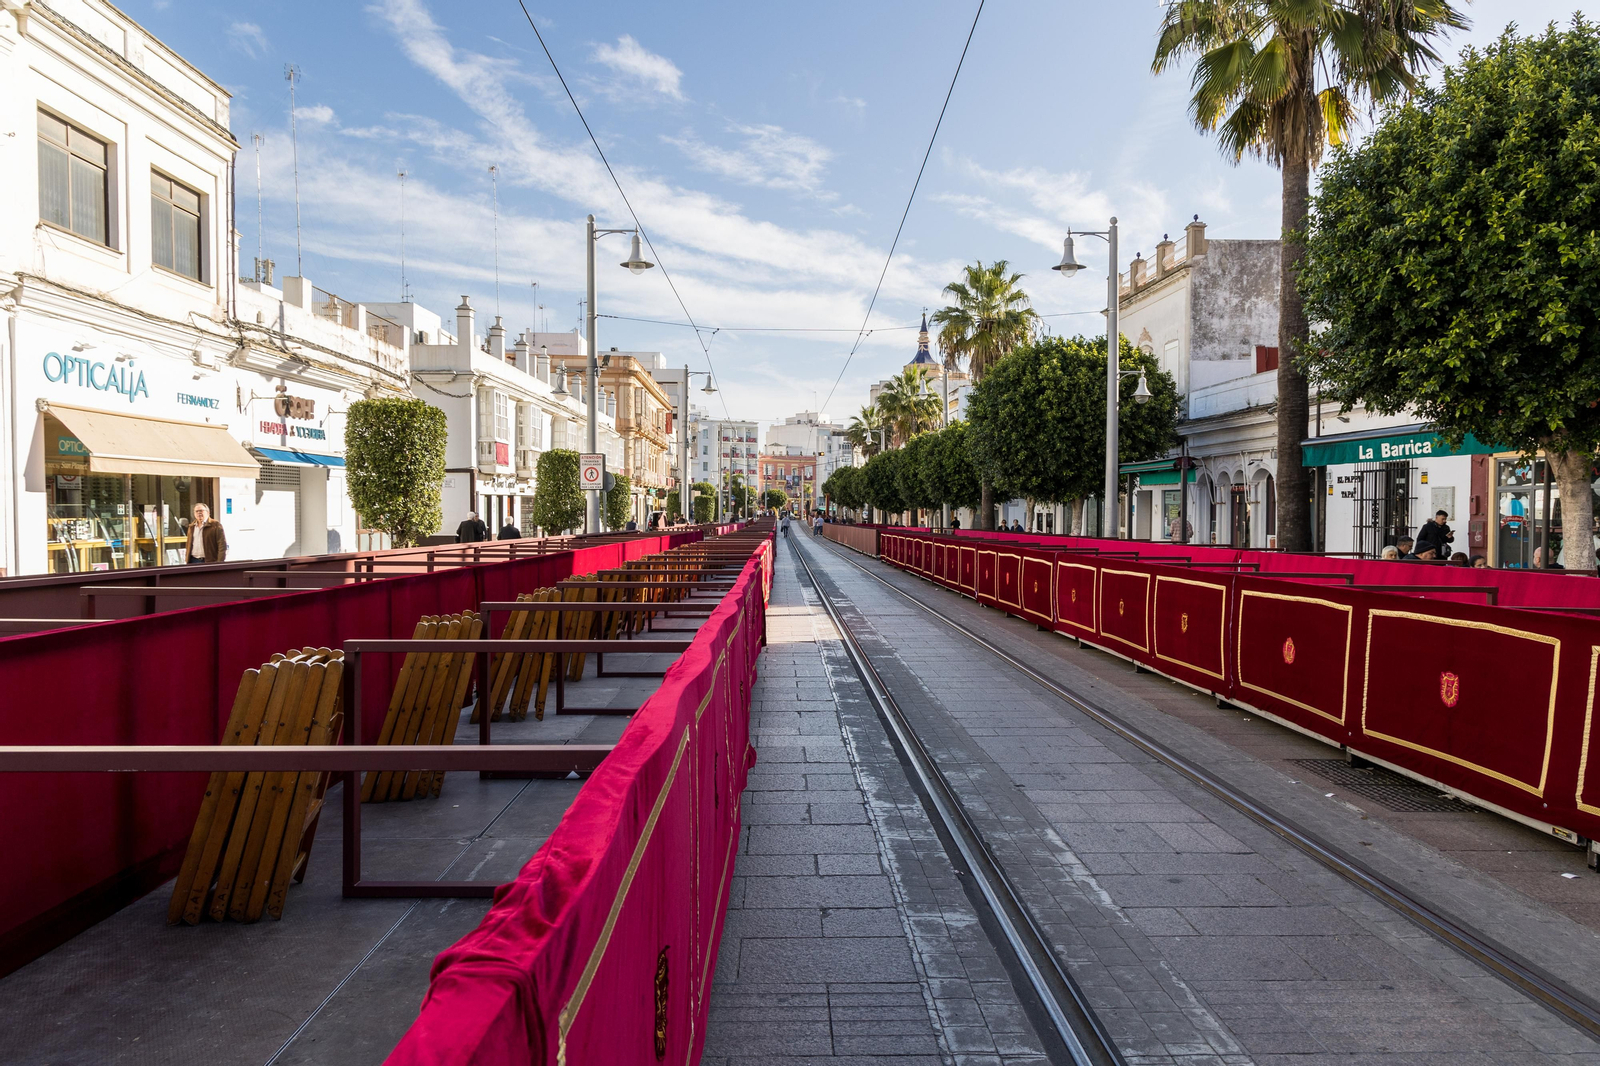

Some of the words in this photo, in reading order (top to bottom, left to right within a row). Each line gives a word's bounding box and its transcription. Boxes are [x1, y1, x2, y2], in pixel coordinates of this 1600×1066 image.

[177, 392, 220, 410] FERNANDEZ
[290, 425, 295, 437] &
[1359, 445, 1374, 460] La
[1381, 439, 1432, 458] Barrica
[212, 883, 230, 916] S.AL
[268, 880, 286, 912] S.AL
